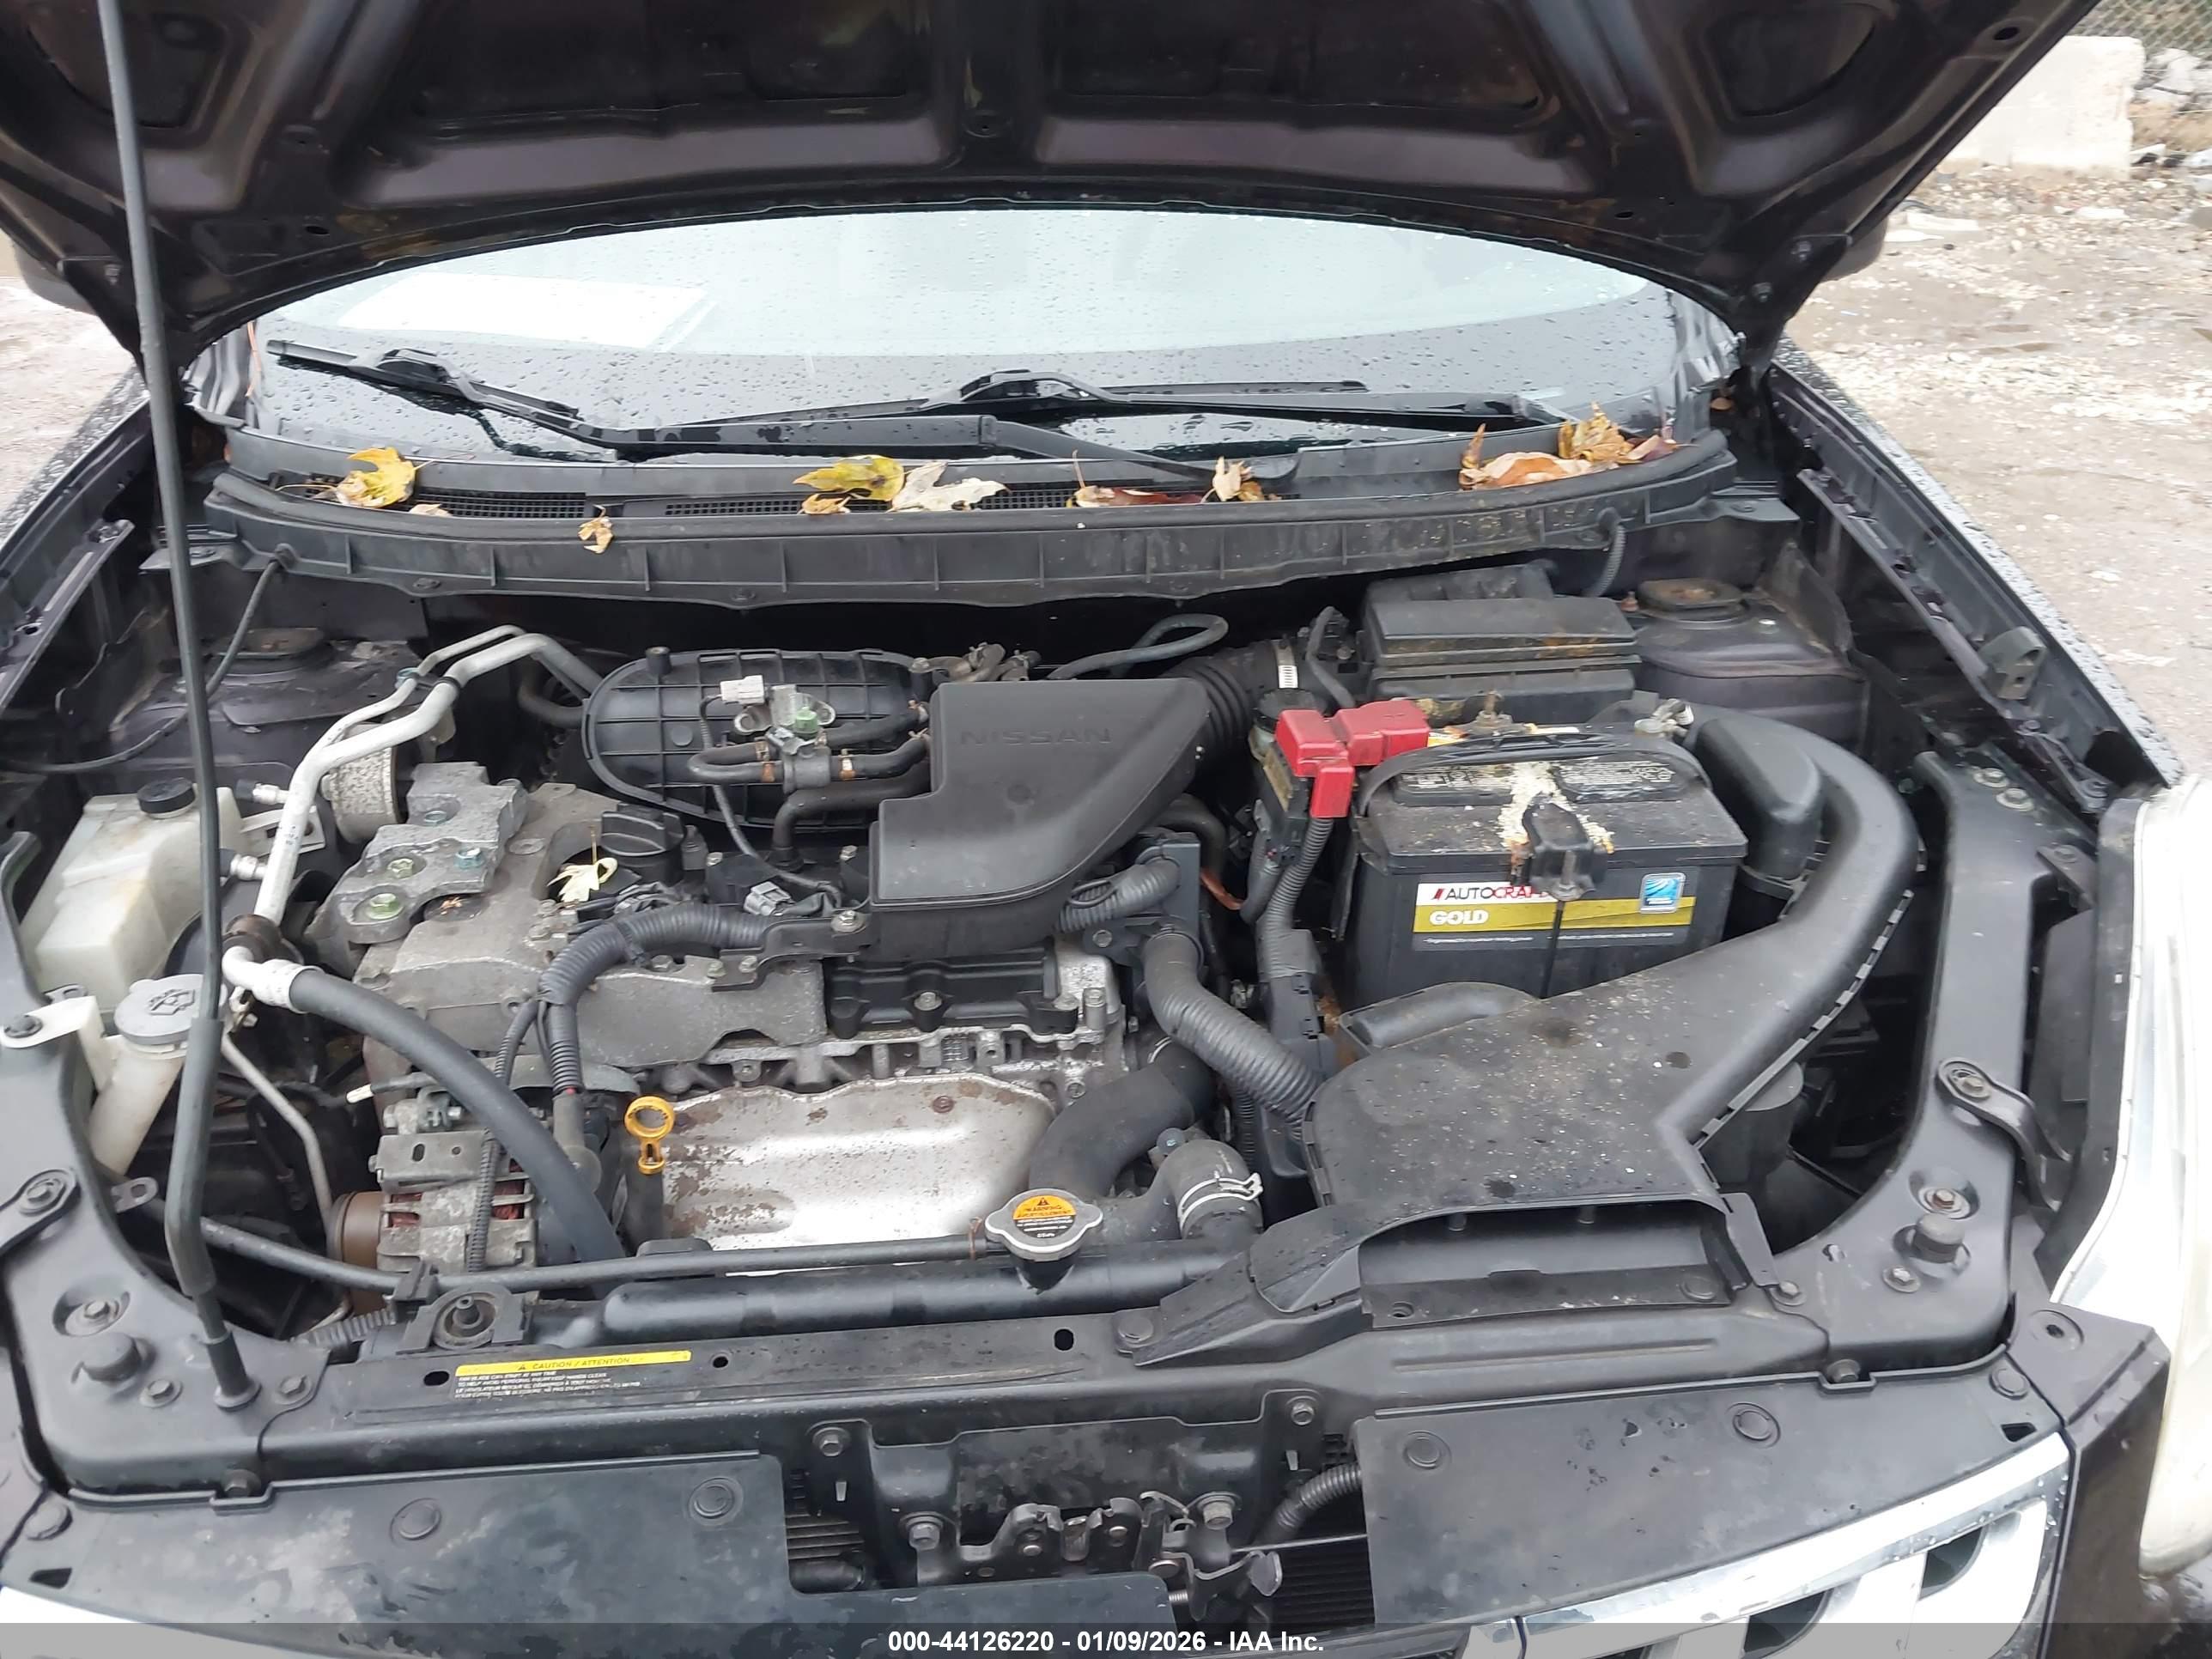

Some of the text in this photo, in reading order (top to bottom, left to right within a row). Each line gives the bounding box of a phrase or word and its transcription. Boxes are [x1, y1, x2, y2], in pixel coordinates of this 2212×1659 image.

[961, 727, 1112, 747] NISSAN
[1444, 885, 1547, 901] AUTOCRA
[1429, 909, 1489, 926] GOLD
[532, 1361, 572, 1370] CAUTION
[581, 1358, 629, 1367] ATTENTION
